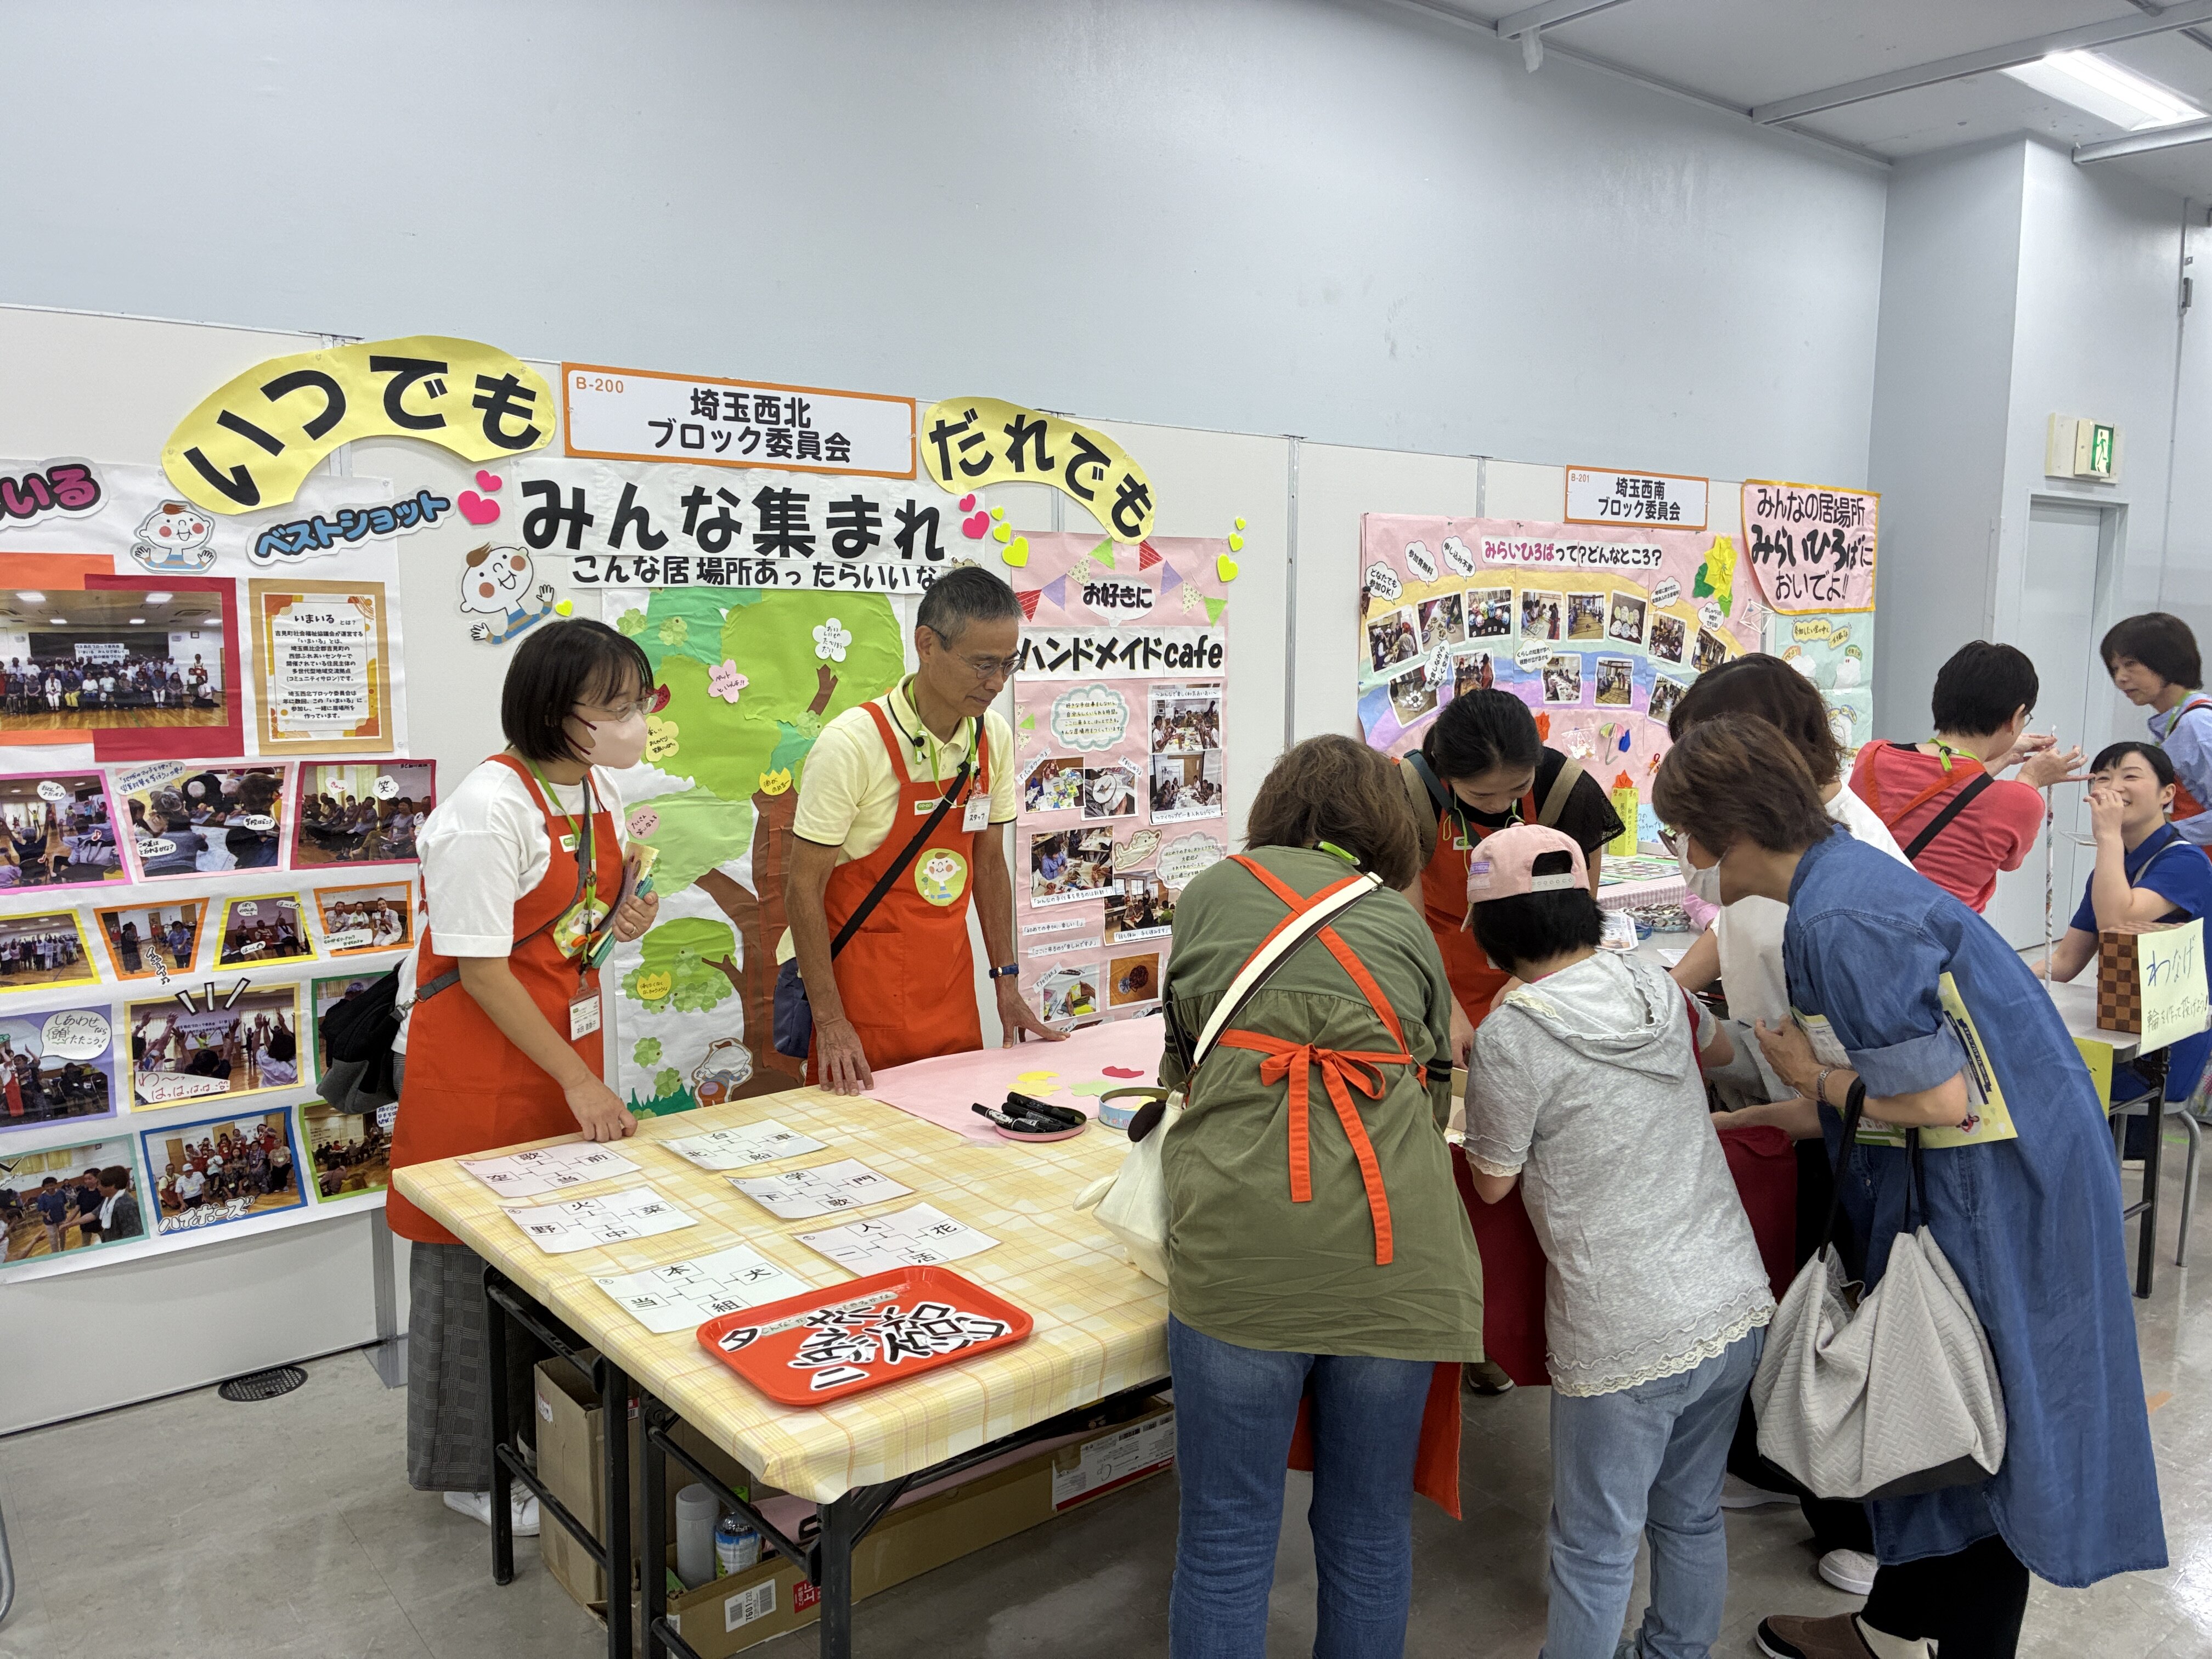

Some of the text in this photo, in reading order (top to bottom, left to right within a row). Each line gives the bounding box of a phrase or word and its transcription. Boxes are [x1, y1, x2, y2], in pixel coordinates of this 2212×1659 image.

[576, 376, 624, 394] B-200
[690, 388, 811, 428] 埼玉西北
[184, 355, 541, 506] いつでも
[648, 419, 851, 463] ブロック委員会
[929, 408, 1153, 538] だれでも
[1571, 473, 1590, 483] B-201
[0, 464, 101, 519] いる
[1616, 477, 1665, 500] 埼玉西南
[1599, 497, 1680, 522] ブロック委員会
[1757, 488, 1865, 528] みんなの居場所
[255, 490, 450, 558] ベストショット
[522, 479, 945, 560] みんな集まれ
[1485, 541, 1662, 566] みらいひろばって?どんなところ?
[1751, 524, 1873, 572] みらいひろばに
[1409, 549, 1434, 576] 参加費無料
[1444, 542, 1474, 573] 申し込み不要
[573, 556, 936, 590] こんな居場所あったらいいな
[1370, 568, 1397, 588] どなたでも
[1083, 583, 1153, 608] お好きに
[1369, 579, 1394, 597] 参加OK!
[295, 614, 335, 624] いまいる
[1019, 635, 1223, 672] ハンドメイドcafe
[2147, 935, 2195, 986] わなげ
[55, 1014, 100, 1028] しあわせ
[2147, 992, 2208, 1032] 輪を作って投げよう!
[52, 1027, 107, 1048] 頭 たたこう!
[94, 1027, 108, 1035] なら
[518, 1151, 543, 1161] 歌
[585, 1154, 609, 1164] 前
[487, 1173, 512, 1182] 空
[557, 1175, 579, 1184] 当
[785, 1172, 808, 1182] 学
[853, 1173, 877, 1186] 門
[571, 1200, 595, 1211] 火
[640, 1204, 667, 1216] 菜
[827, 1196, 853, 1207] 歌
[531, 1224, 556, 1234] 野
[605, 1229, 628, 1239] 中
[860, 1223, 882, 1233] 人
[929, 1222, 959, 1236] 花
[912, 1251, 936, 1263] 活
[663, 1265, 690, 1277] 本
[745, 1267, 771, 1282] 犬
[631, 1297, 658, 1309] 当
[712, 1300, 740, 1313] 組
[745, 1602, 753, 1622] 7601
